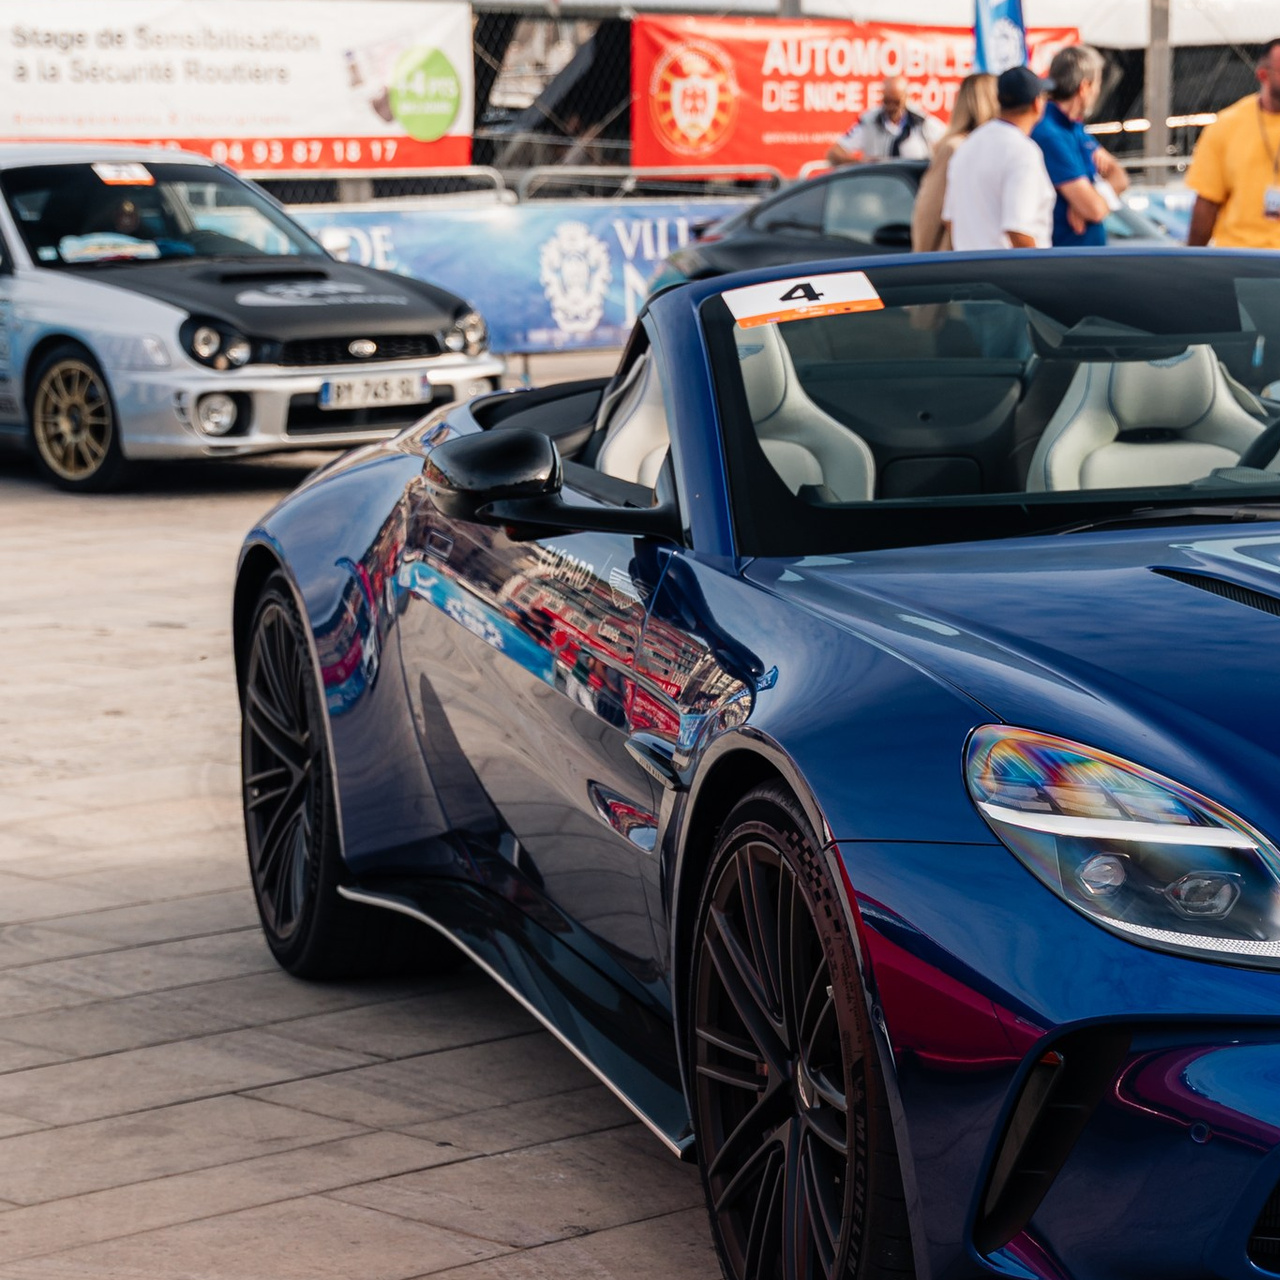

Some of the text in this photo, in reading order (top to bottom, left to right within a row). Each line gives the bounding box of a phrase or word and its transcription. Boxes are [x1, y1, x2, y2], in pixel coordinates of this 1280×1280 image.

[12, 25, 320, 54] Stage de Sensibilisation
[37, 61, 61, 83] la
[69, 60, 176, 84] Sécurité
[762, 37, 973, 78] AUTOMOBILE
[762, 77, 961, 113] DE NICE E CÔT
[210, 139, 398, 164] 04 93 87 18 17
[779, 282, 824, 302] 4
[848, 1113, 867, 1276] MICHELIN
